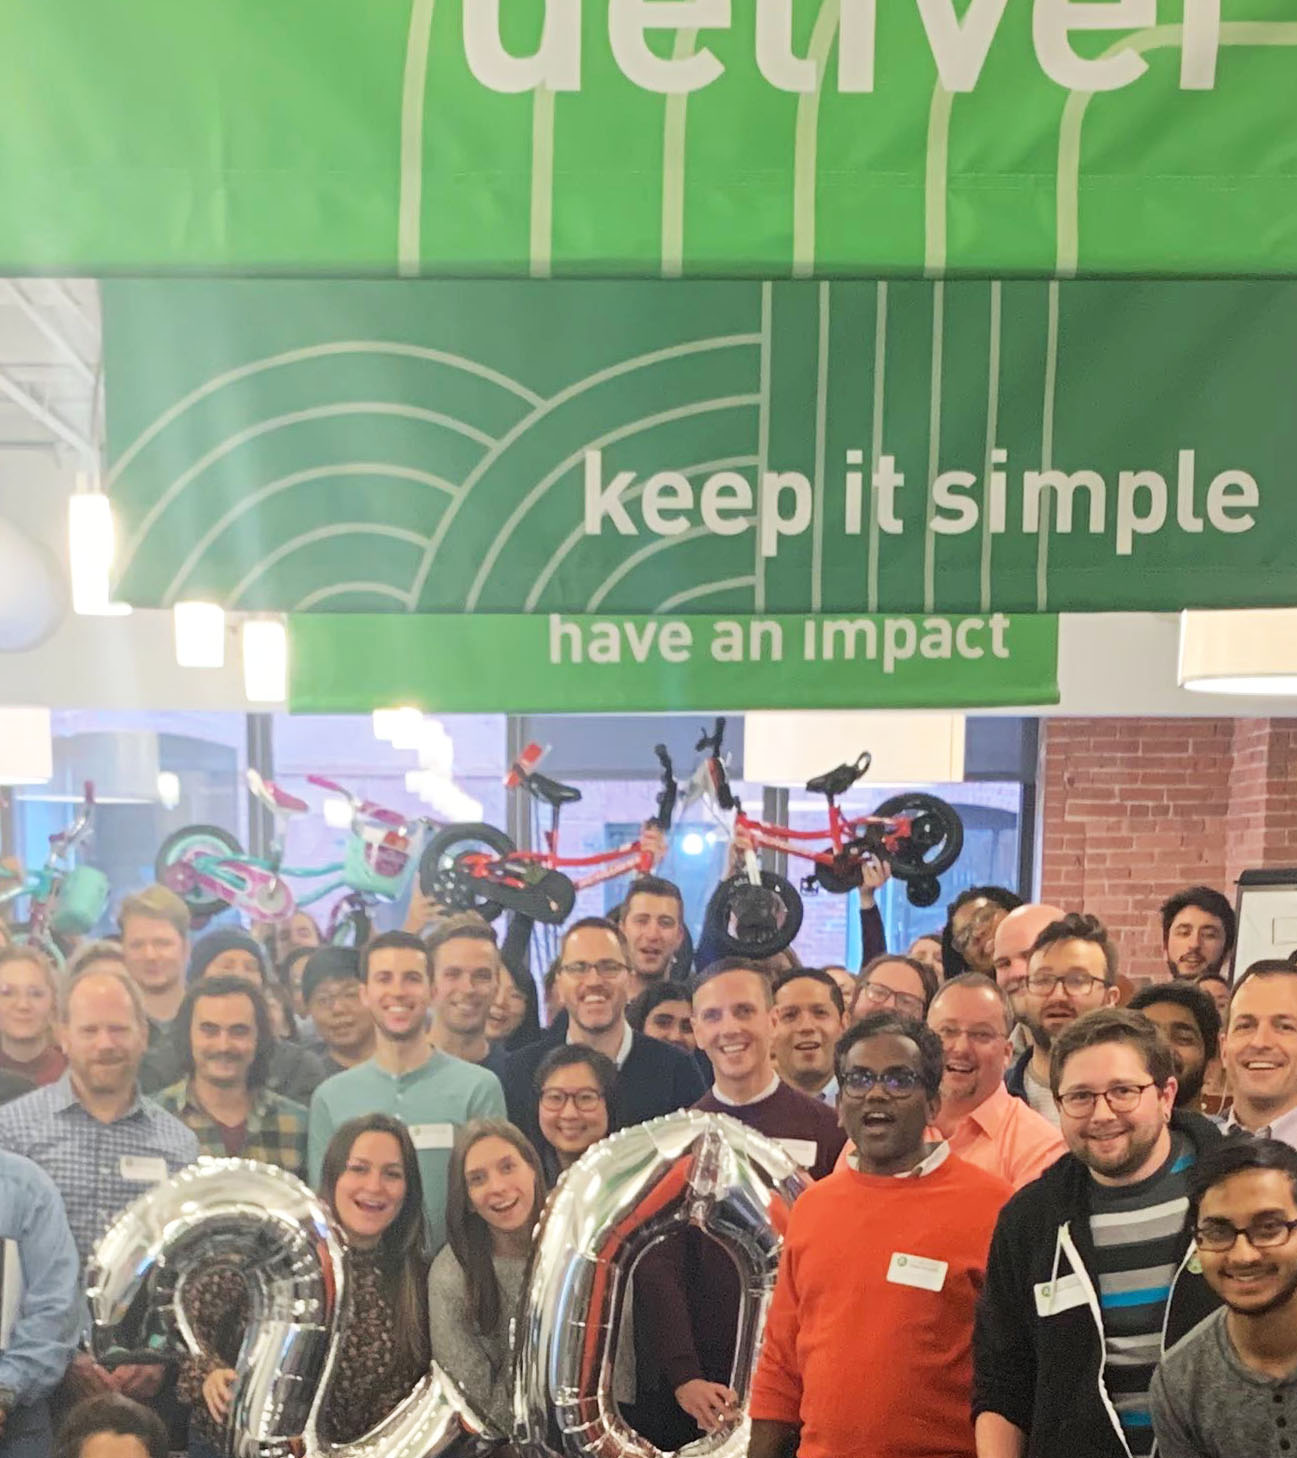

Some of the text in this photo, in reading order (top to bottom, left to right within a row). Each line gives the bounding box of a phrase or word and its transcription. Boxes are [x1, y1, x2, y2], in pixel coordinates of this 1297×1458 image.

[584, 449, 1260, 557] keep it simple
[548, 613, 1011, 674] have an impact
